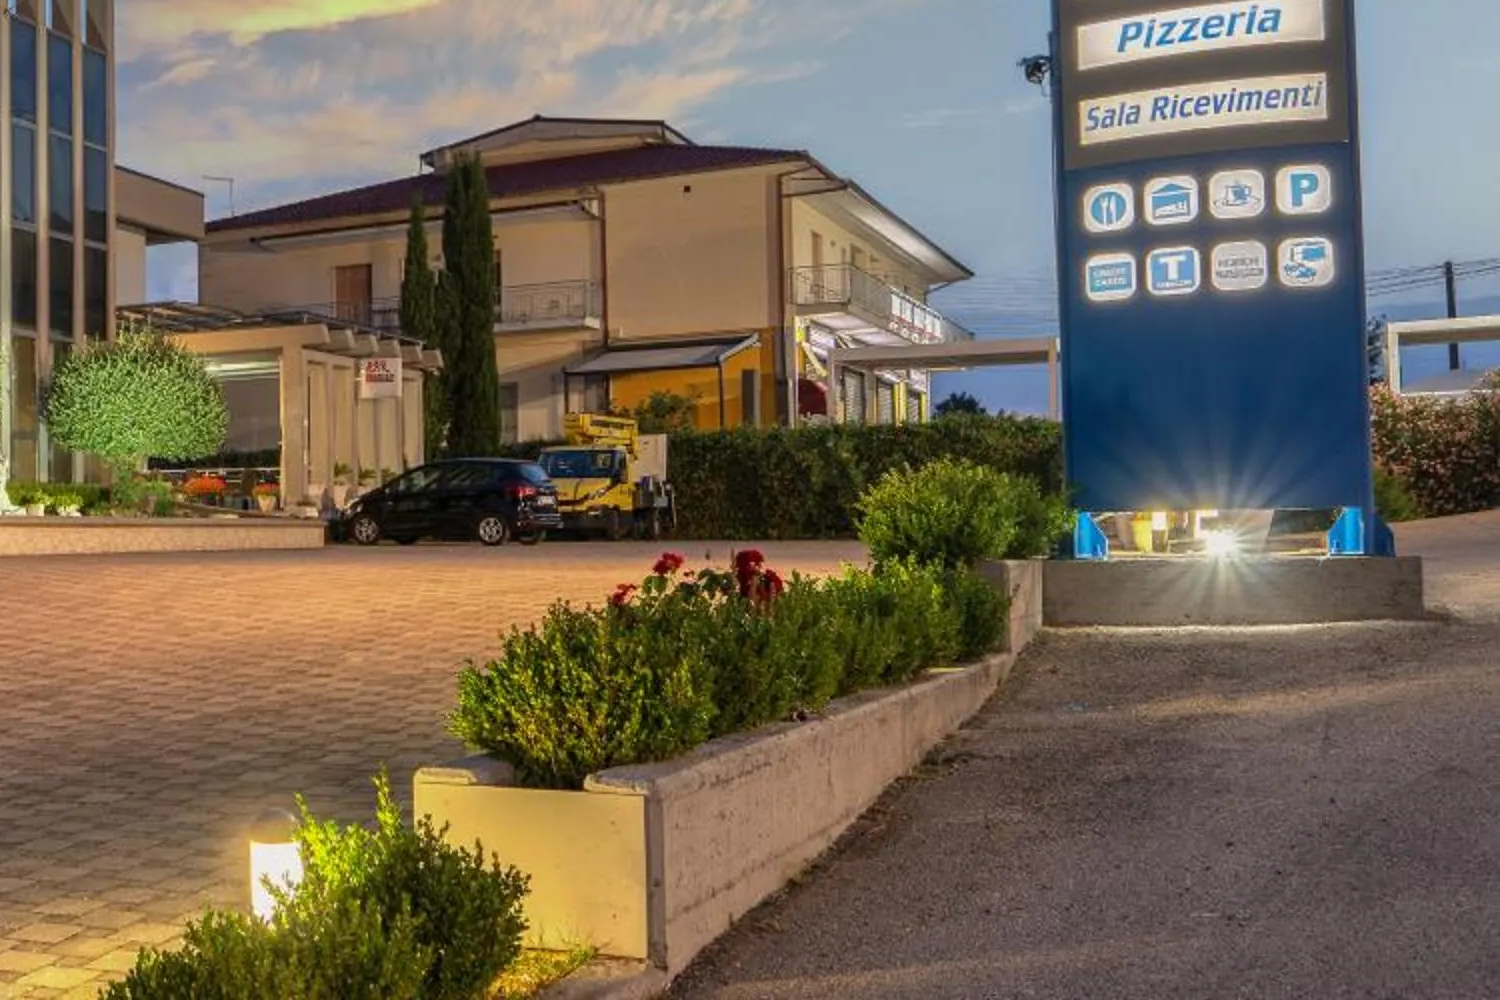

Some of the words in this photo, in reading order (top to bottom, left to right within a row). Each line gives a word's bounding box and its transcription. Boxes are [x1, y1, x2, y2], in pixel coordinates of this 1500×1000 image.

[1117, 5, 1282, 53] Pizzeria
[1085, 102, 1141, 131] Sala
[1150, 81, 1324, 122] Ricevimenti
[1288, 172, 1319, 209] P
[1159, 254, 1187, 281] T
